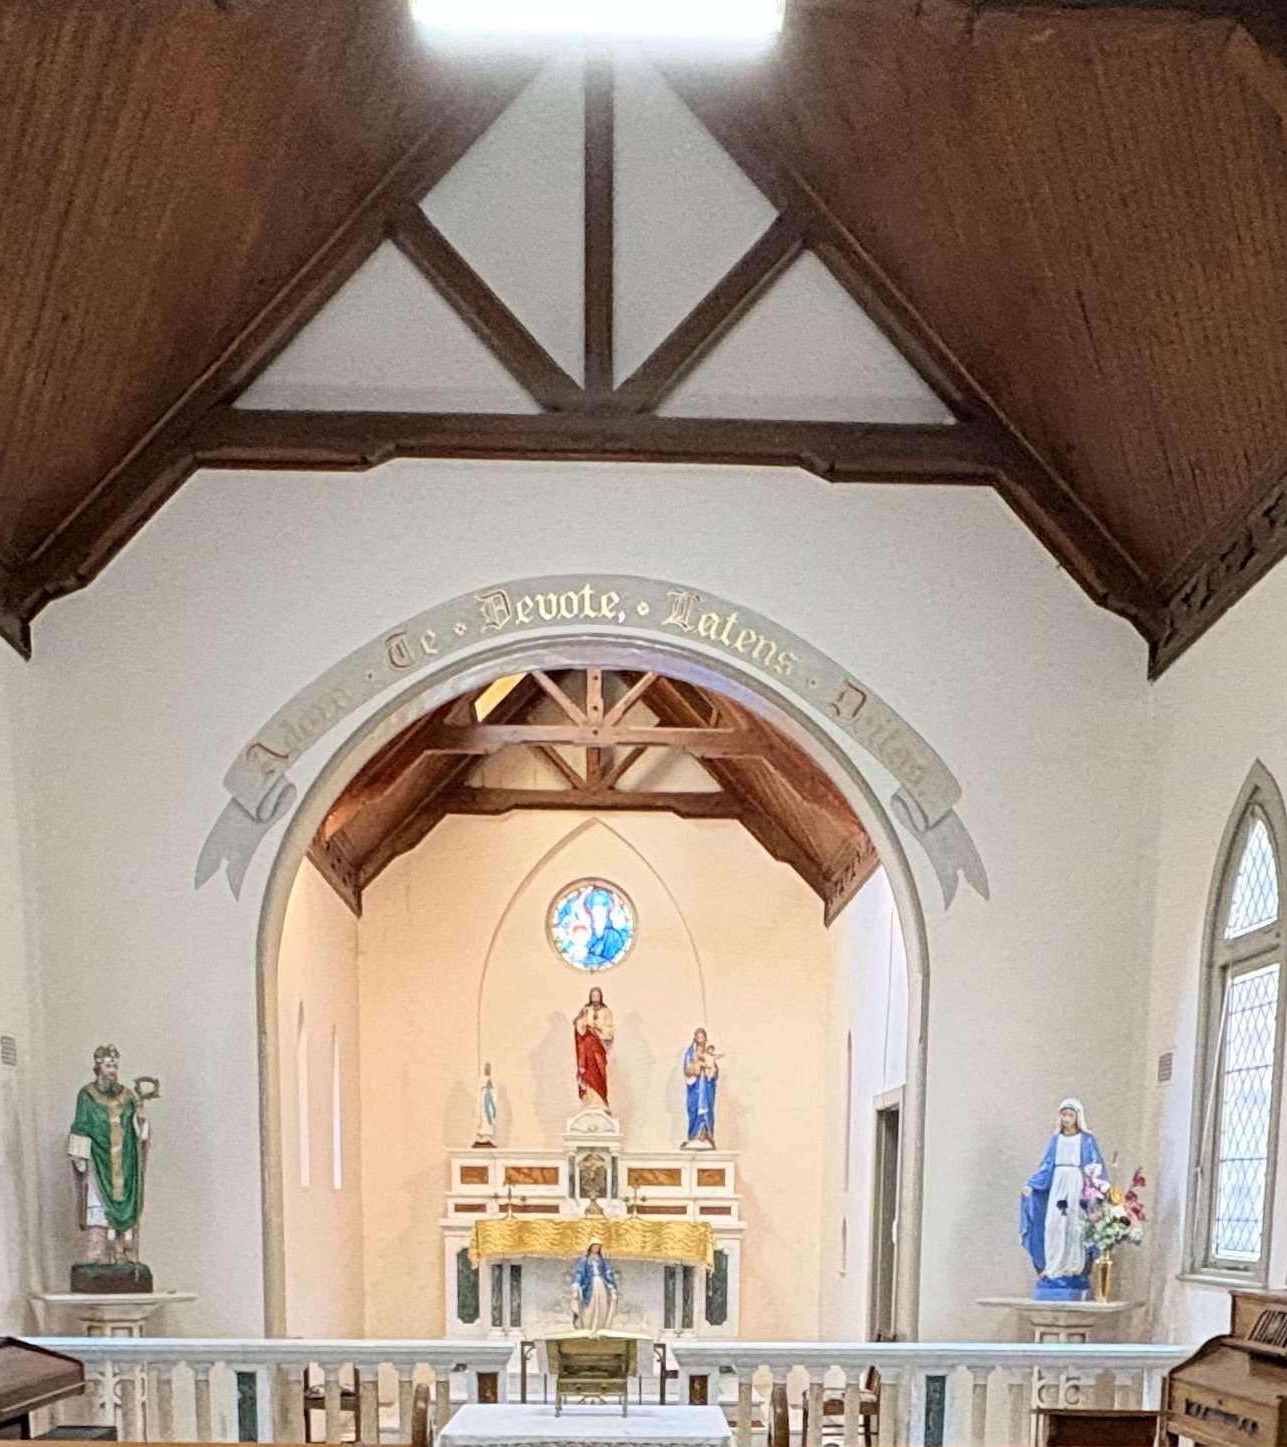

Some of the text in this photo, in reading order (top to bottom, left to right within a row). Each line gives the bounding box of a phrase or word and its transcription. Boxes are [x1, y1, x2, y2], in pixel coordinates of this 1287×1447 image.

[384, 629, 441, 671] Te
[475, 583, 626, 631] Devote,
[661, 588, 799, 677] Latens
